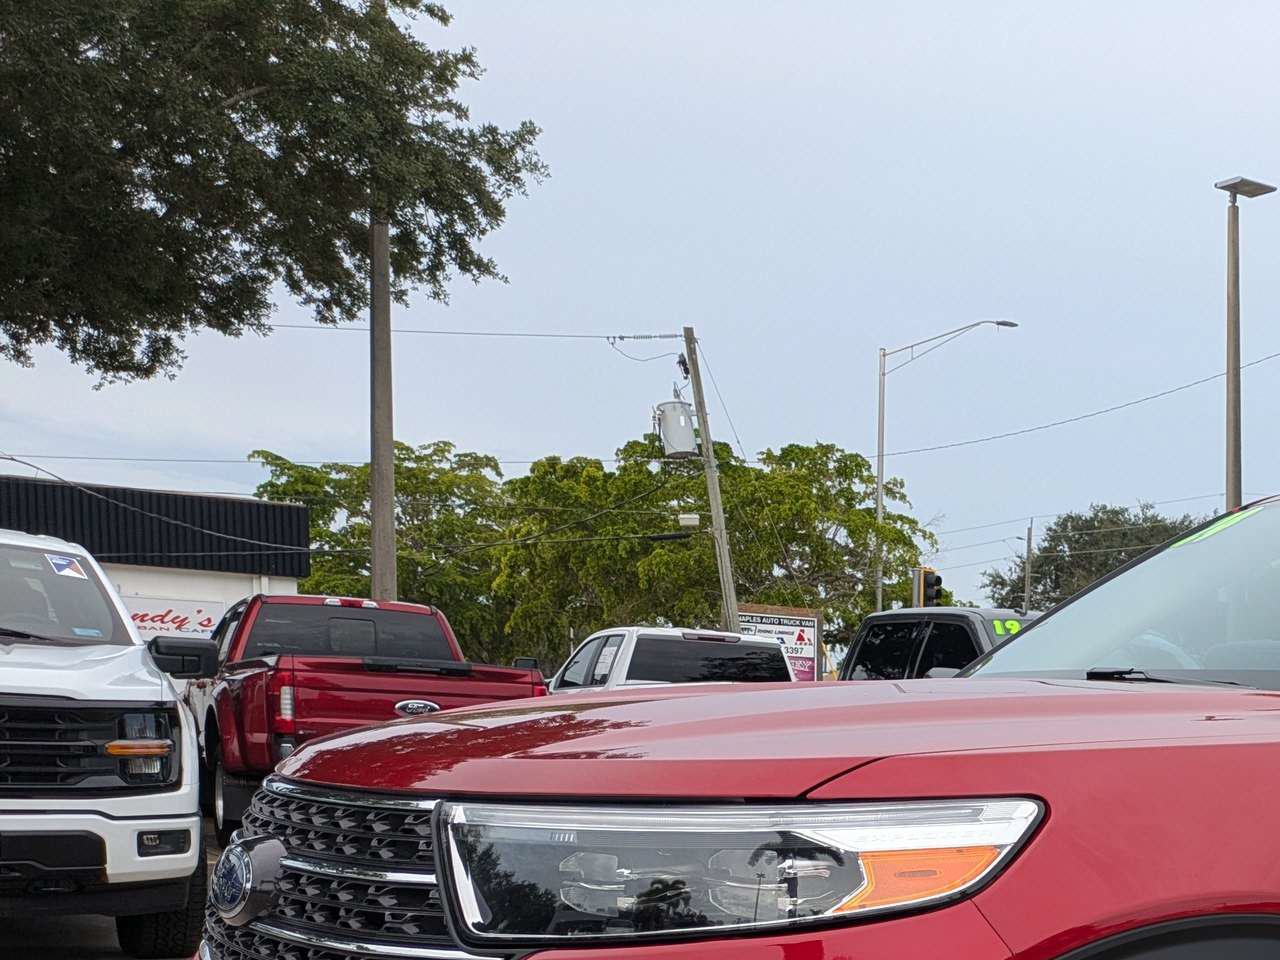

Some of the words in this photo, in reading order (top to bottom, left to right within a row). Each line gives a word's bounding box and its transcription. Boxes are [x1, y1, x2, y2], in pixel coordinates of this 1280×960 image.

[130, 608, 216, 630] ndy's
[179, 626, 213, 635] CAF
[993, 619, 1021, 635] 19
[784, 646, 804, 654] 3397
